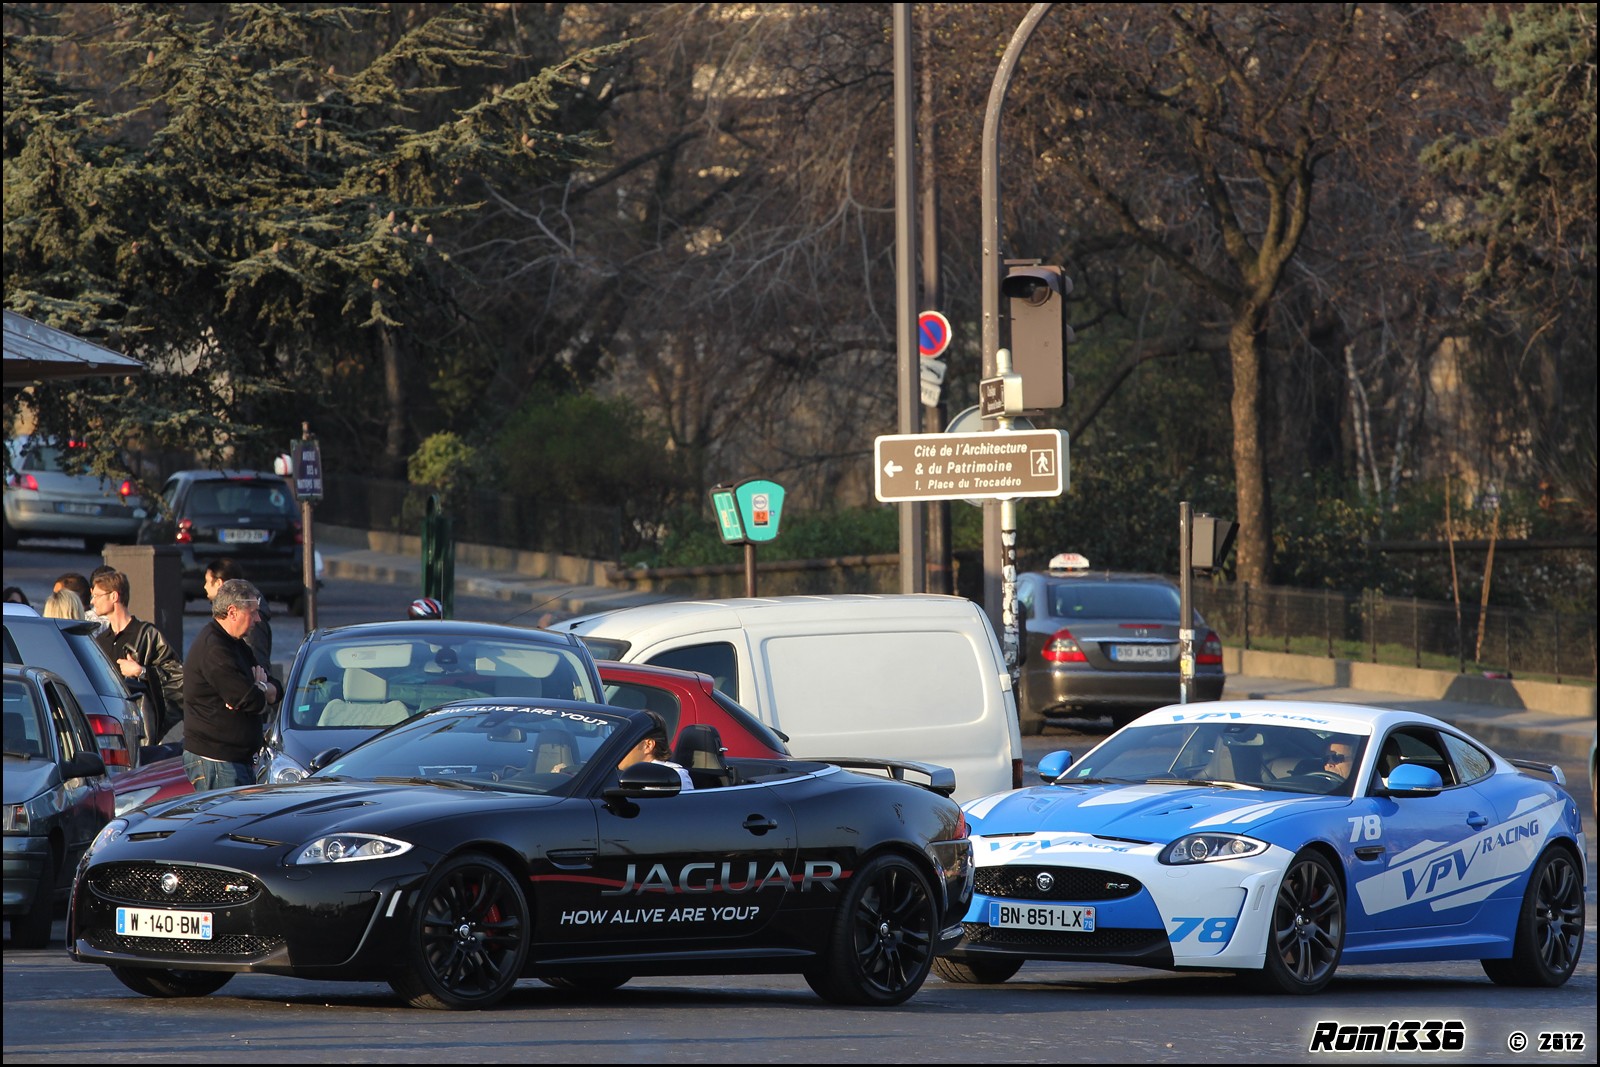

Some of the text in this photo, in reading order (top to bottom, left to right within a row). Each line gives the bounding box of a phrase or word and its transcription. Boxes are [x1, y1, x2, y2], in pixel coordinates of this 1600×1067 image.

[914, 443, 1028, 458] Cité de l'Architecture
[915, 461, 1013, 476] & du Patrimoine
[928, 478, 955, 490] Place
[958, 478, 970, 488] du
[974, 477, 1022, 488] Trocadéro
[517, 706, 557, 716] ARE
[560, 711, 609, 727] YOU?
[1347, 814, 1381, 843] 78
[1402, 819, 1539, 900] VPV RACING
[601, 860, 842, 896] JAGUAR
[560, 906, 760, 925] HOW ALIVE ARE YOU?
[1084, 919, 1094, 930] 78
[1168, 916, 1239, 943] 78
